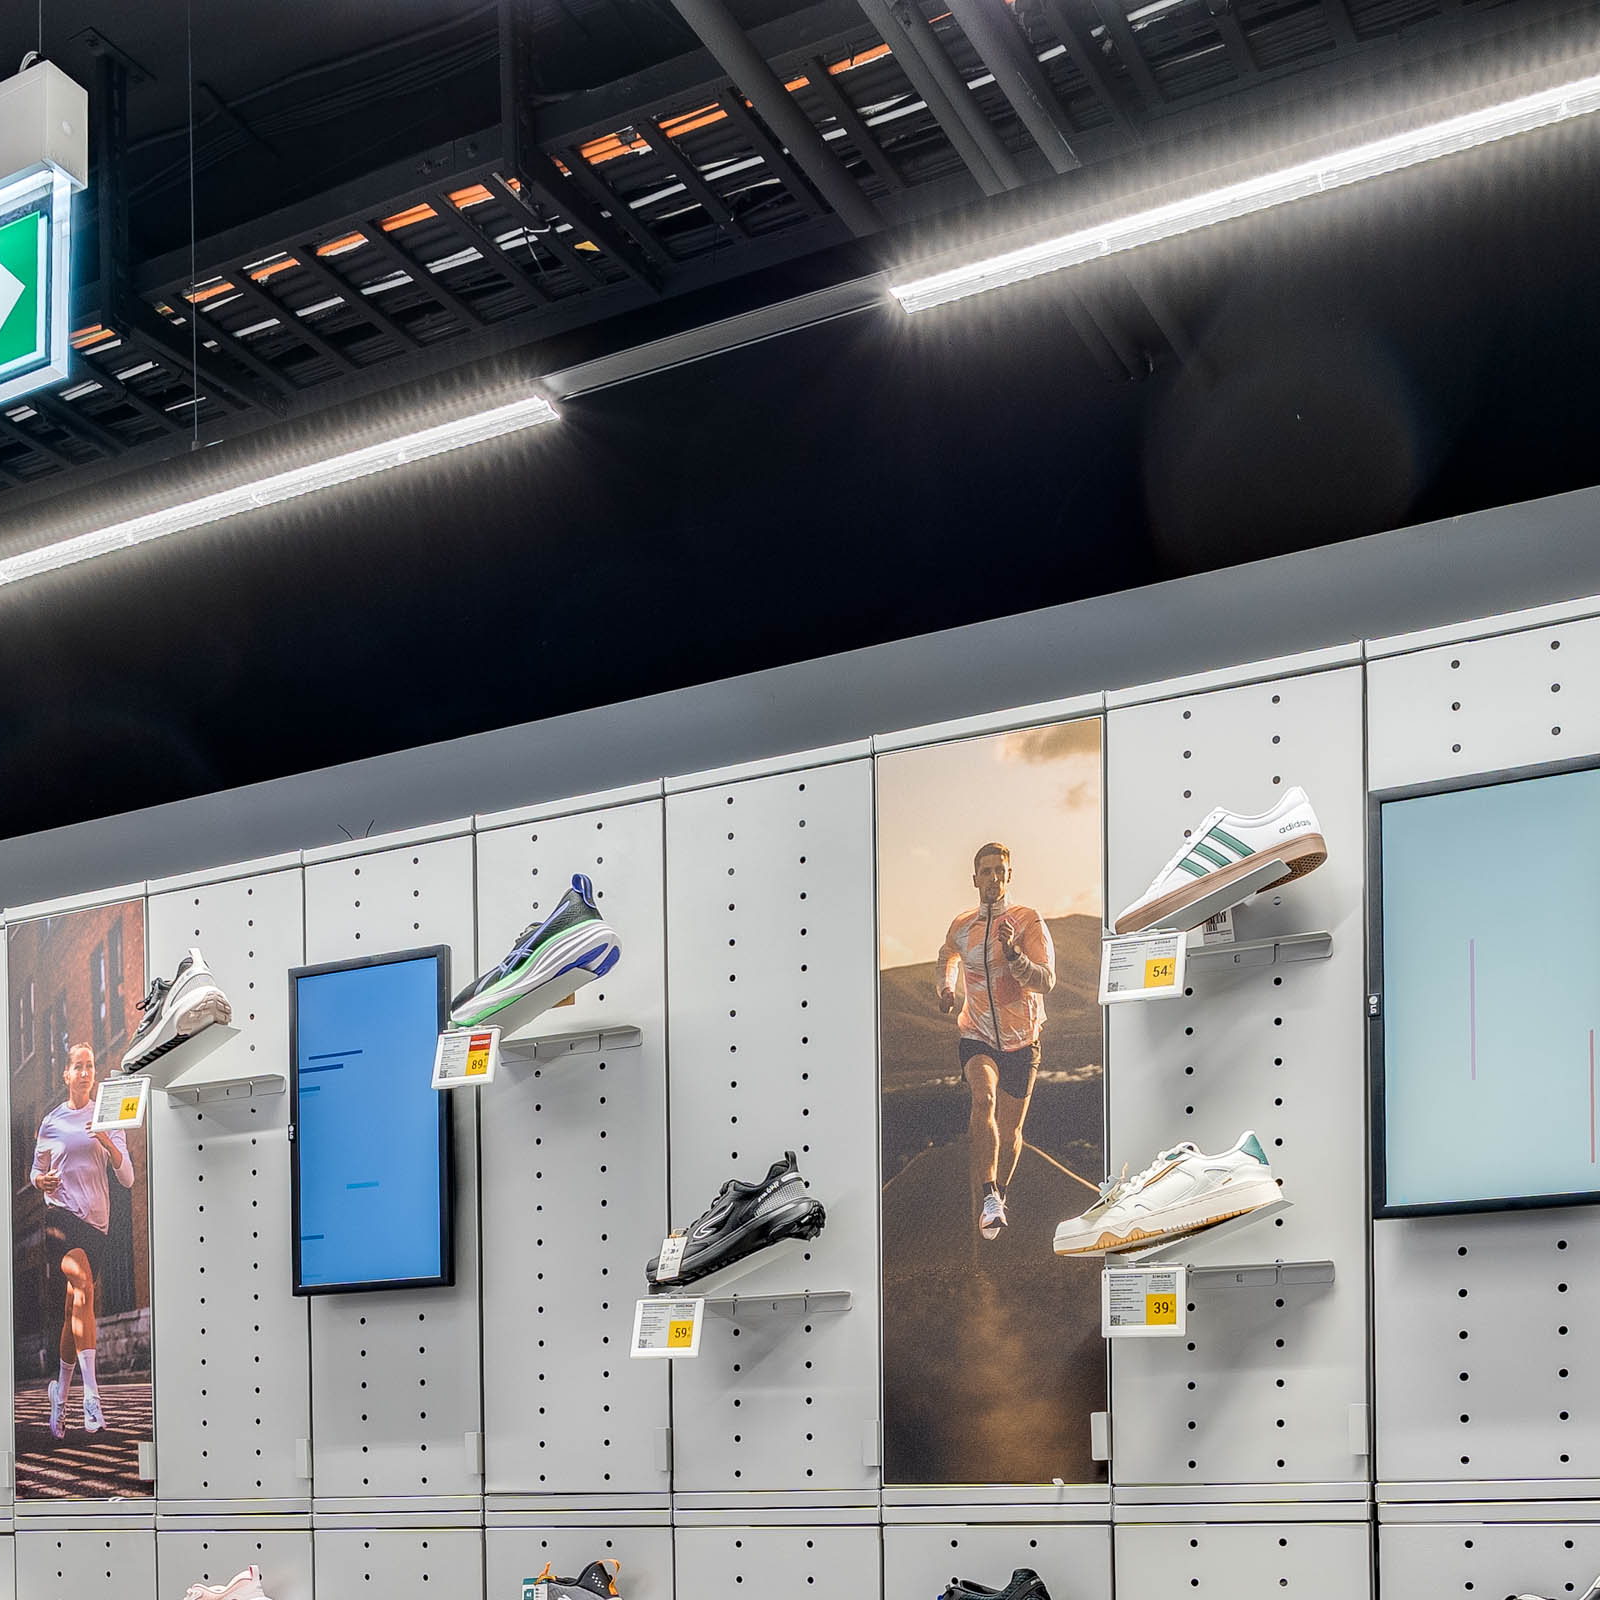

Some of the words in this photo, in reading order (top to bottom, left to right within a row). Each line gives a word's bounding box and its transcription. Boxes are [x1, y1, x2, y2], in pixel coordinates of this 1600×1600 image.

[1279, 820, 1311, 833] adidas
[1153, 965, 1168, 978] 54
[472, 1059, 483, 1070] 89
[1153, 1302, 1169, 1314] 39
[675, 1327, 688, 1338] 59
